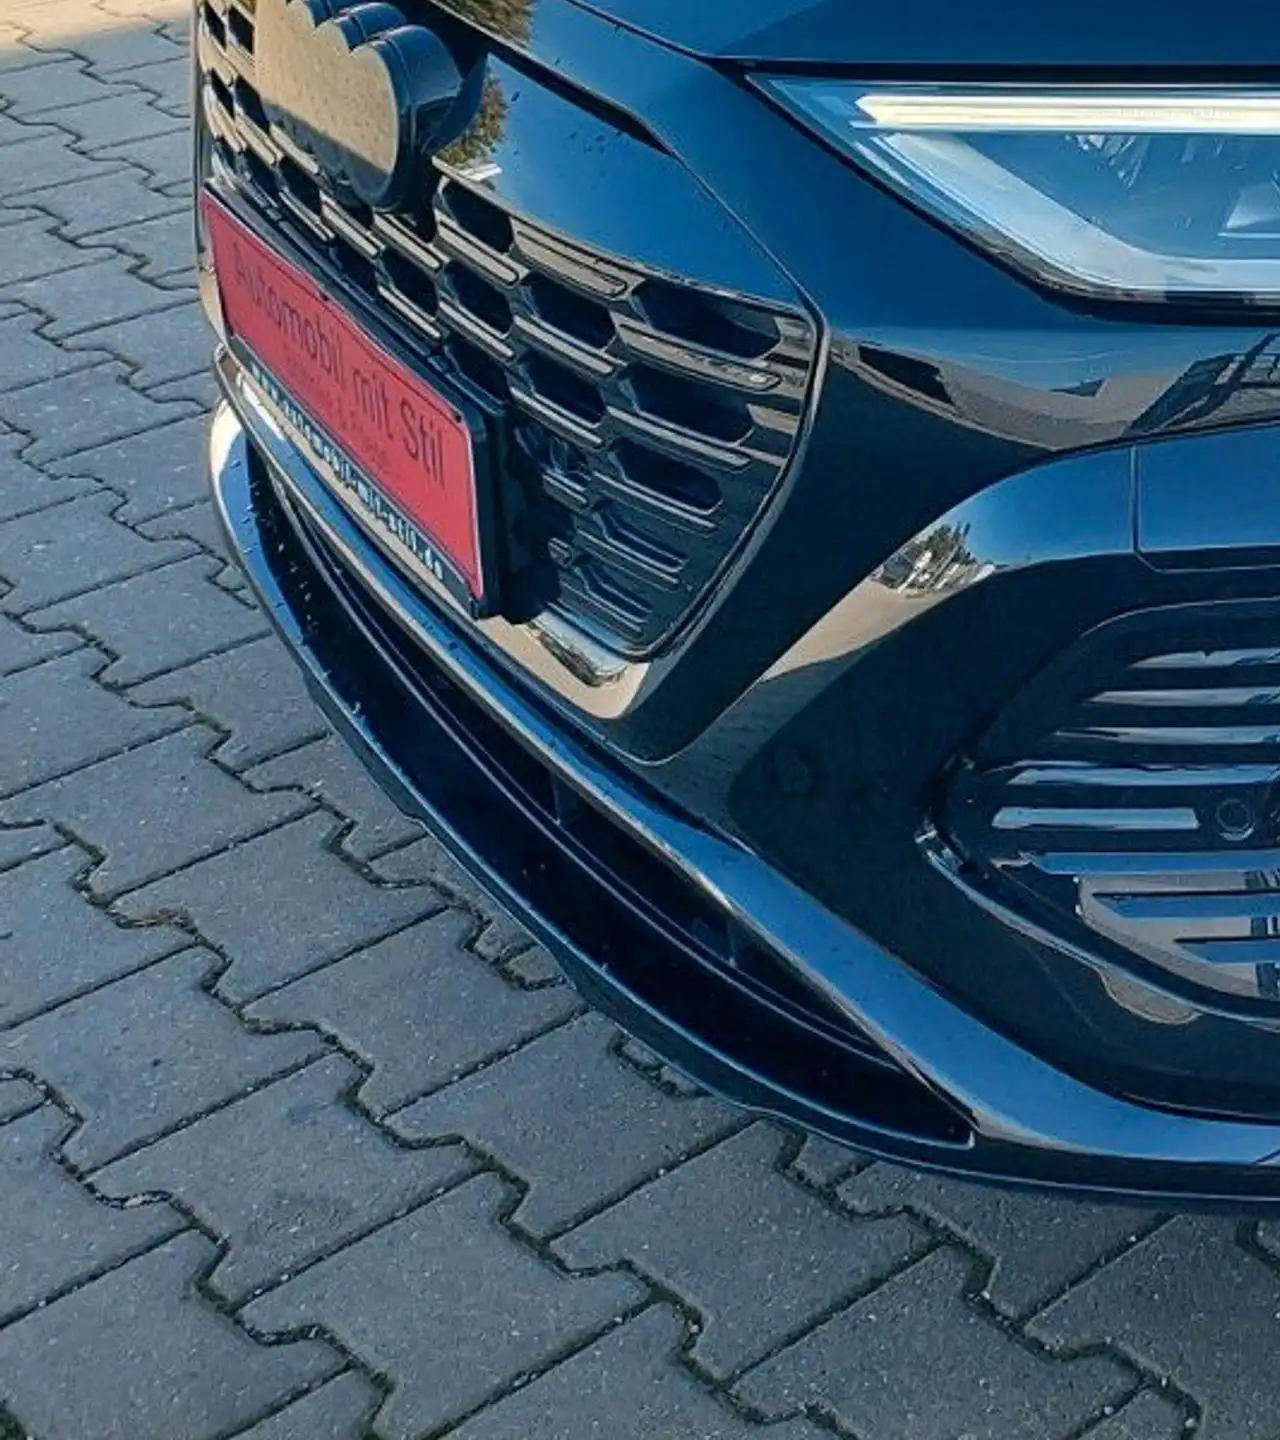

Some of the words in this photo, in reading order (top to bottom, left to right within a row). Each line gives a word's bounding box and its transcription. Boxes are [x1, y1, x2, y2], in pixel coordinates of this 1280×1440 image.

[231, 240, 346, 391] Automobil
[352, 365, 394, 441] mit
[400, 396, 446, 494] Stil
